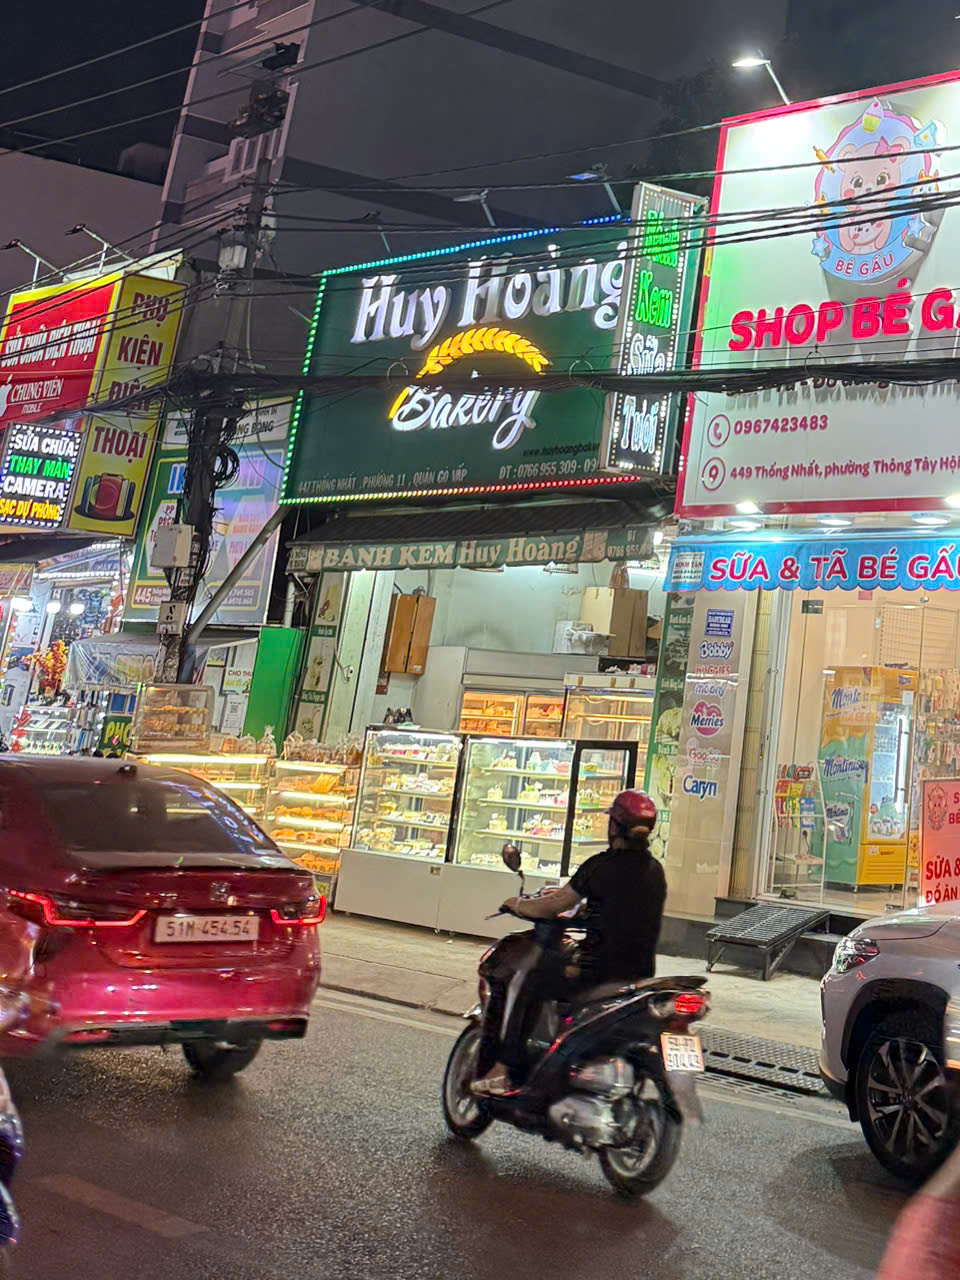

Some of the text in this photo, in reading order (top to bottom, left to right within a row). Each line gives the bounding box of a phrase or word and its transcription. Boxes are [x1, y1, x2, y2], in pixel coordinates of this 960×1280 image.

[834, 252, 893, 276] BÉ GẤU
[350, 242, 628, 351] Huy Hoàng
[131, 292, 170, 328] PHỤ
[728, 299, 844, 351] SHOP
[851, 277, 912, 340] BÉ
[117, 334, 163, 370] KIỆN
[11, 379, 41, 402] CHUNG
[733, 414, 829, 435] 0967423483
[14, 430, 75, 457] SỬA CHỮA
[93, 426, 148, 463] THOẠI
[9, 455, 72, 480] THAY MÀN
[730, 467, 753, 480] 449
[754, 460, 790, 480] Thống
[791, 460, 823, 479] Nhất,
[824, 460, 870, 481] phường
[873, 458, 913, 478] Thông
[914, 457, 938, 477] Tây
[3, 476, 65, 499] CAMERA
[16, 499, 32, 520] DỰ
[31, 500, 61, 521] PHÒNG
[323, 544, 393, 568] BÁNH
[399, 543, 456, 566] KEM
[458, 540, 500, 567] Huy
[506, 535, 579, 562] Hoàng
[709, 550, 769, 581] SỮA
[779, 557, 801, 581] &
[810, 548, 849, 581] TÃ
[858, 548, 898, 580] BÉ
[135, 587, 151, 604] 445
[700, 640, 734, 660] Bobby
[691, 713, 724, 728] Merries
[683, 775, 717, 800] Caryn
[926, 855, 951, 880] SỮA
[925, 882, 941, 903] ĐỒ
[943, 883, 958, 901] ĂN
